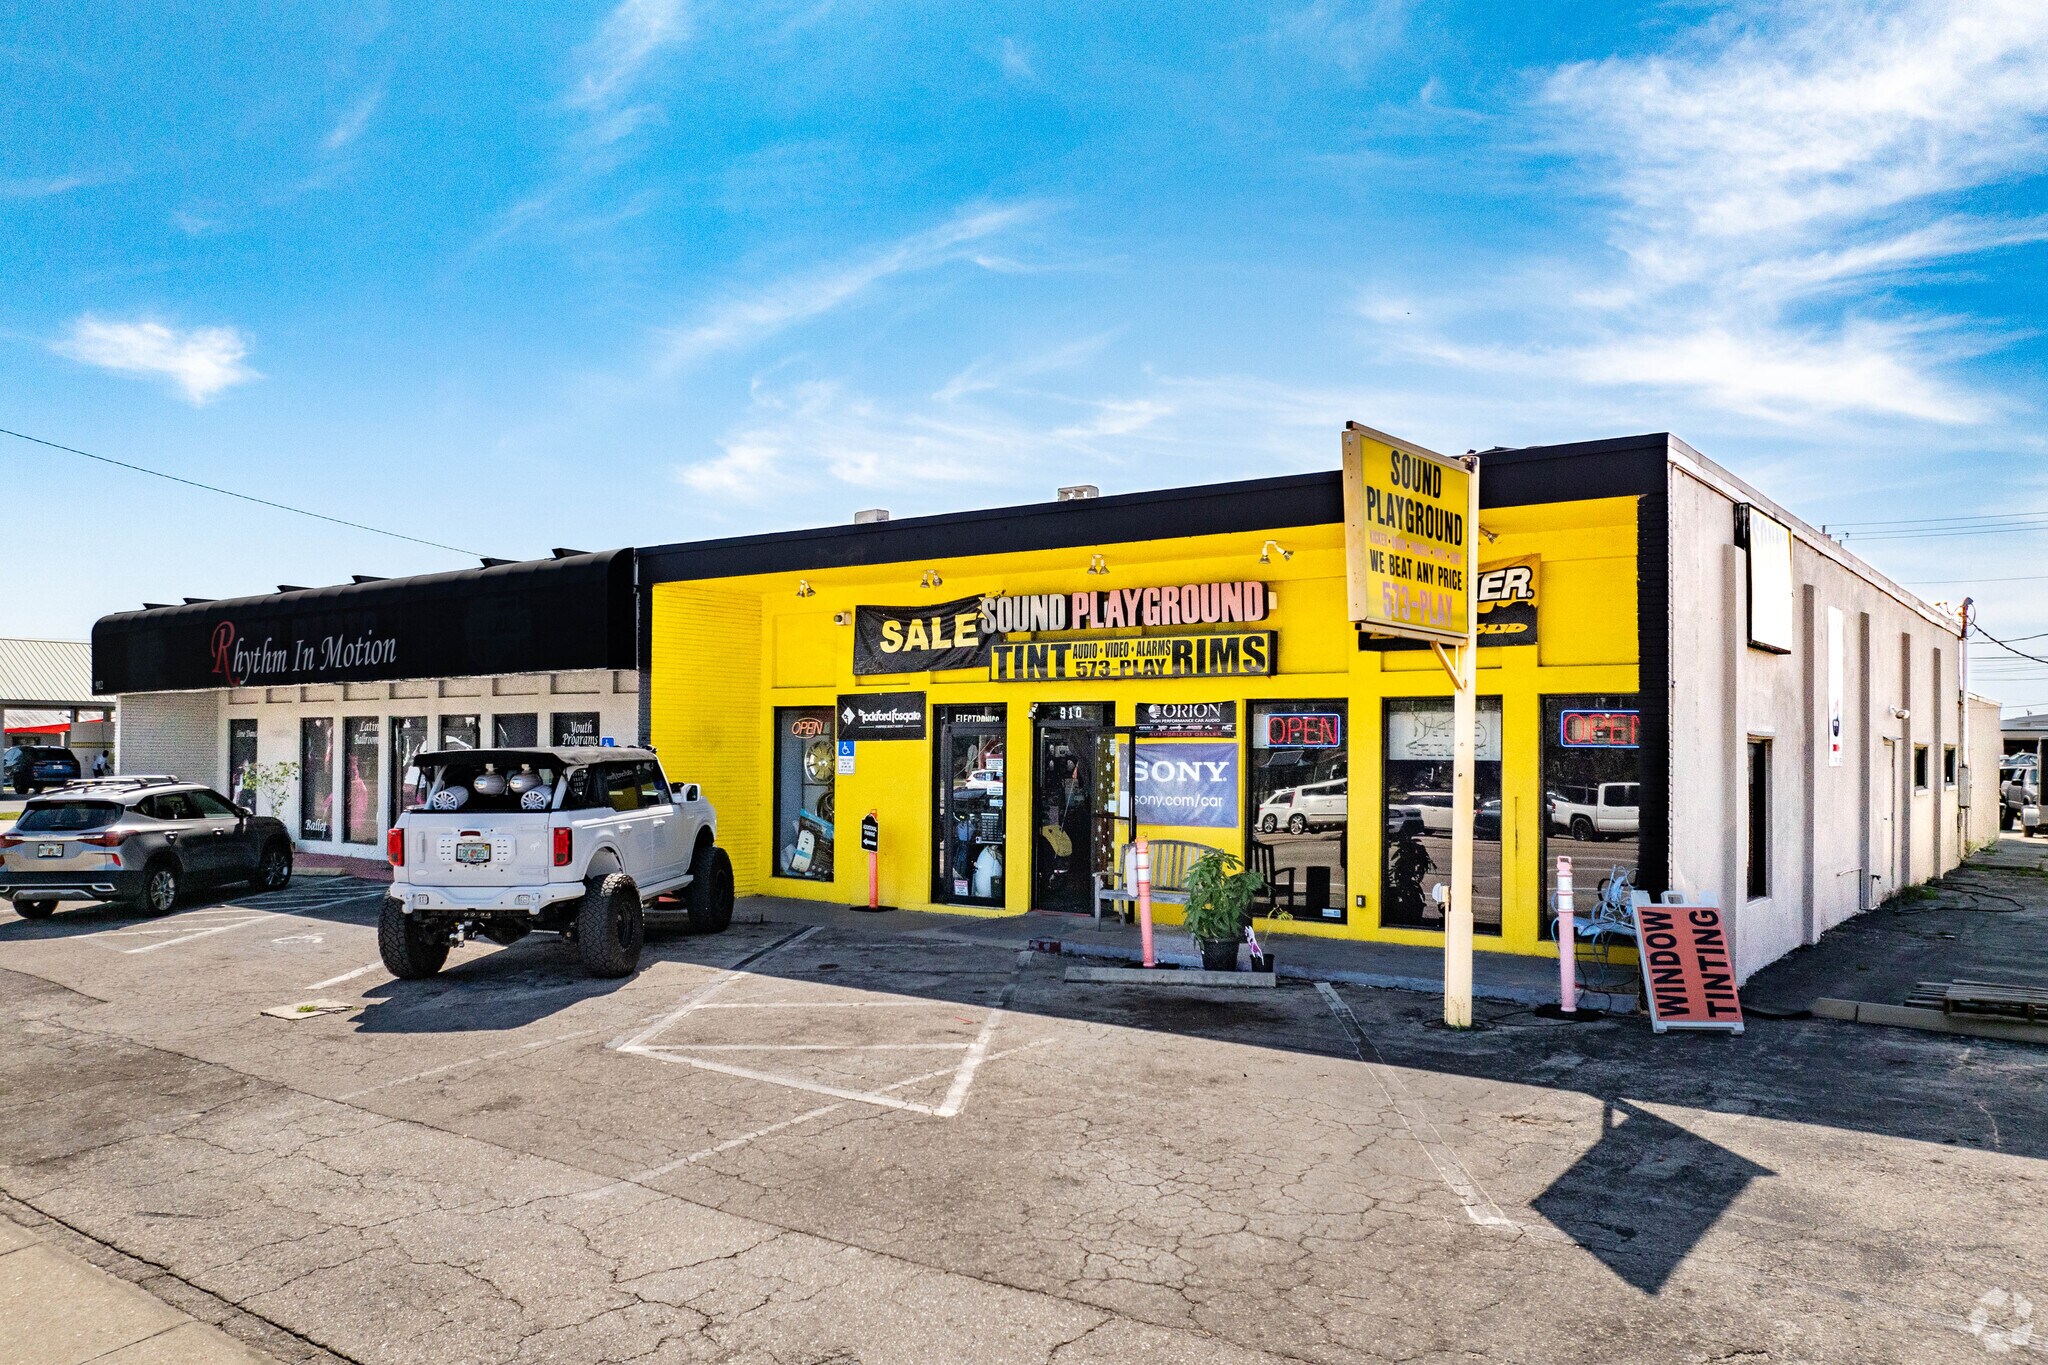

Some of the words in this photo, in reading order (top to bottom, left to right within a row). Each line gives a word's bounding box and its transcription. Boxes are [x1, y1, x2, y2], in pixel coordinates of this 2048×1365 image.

[1390, 450, 1442, 499] SOUND
[1366, 485, 1463, 546] PLAYGROUND
[1369, 549, 1385, 574] WE
[1389, 556, 1413, 580] BEAT
[1417, 561, 1435, 585] ANY
[1438, 566, 1462, 591] PRICE
[981, 593, 1066, 634] SOUND
[1072, 581, 1265, 630] PLAYGROUND
[1382, 581, 1453, 628] 573-PLAY
[879, 613, 980, 653] SALE
[1072, 642, 1098, 659] AUDIO
[1104, 642, 1130, 658] VIDEO
[1136, 640, 1171, 656] ALARMS
[211, 620, 287, 687] Rhythm
[292, 639, 315, 672] In
[319, 629, 397, 671] Motion
[993, 643, 1072, 679] TINT
[1075, 658, 1167, 678] 573-PLAY
[1172, 636, 1266, 675] RIMS
[570, 720, 593, 735] Youth
[791, 720, 824, 735] OPEN
[1059, 706, 1082, 719] 910
[1162, 704, 1221, 718] ORION
[562, 733, 599, 746] Programs
[1267, 717, 1337, 744] OPEN
[305, 819, 328, 832] Ballet
[1641, 910, 1690, 1018] WINDOW
[1688, 909, 1738, 1018] TINTING
